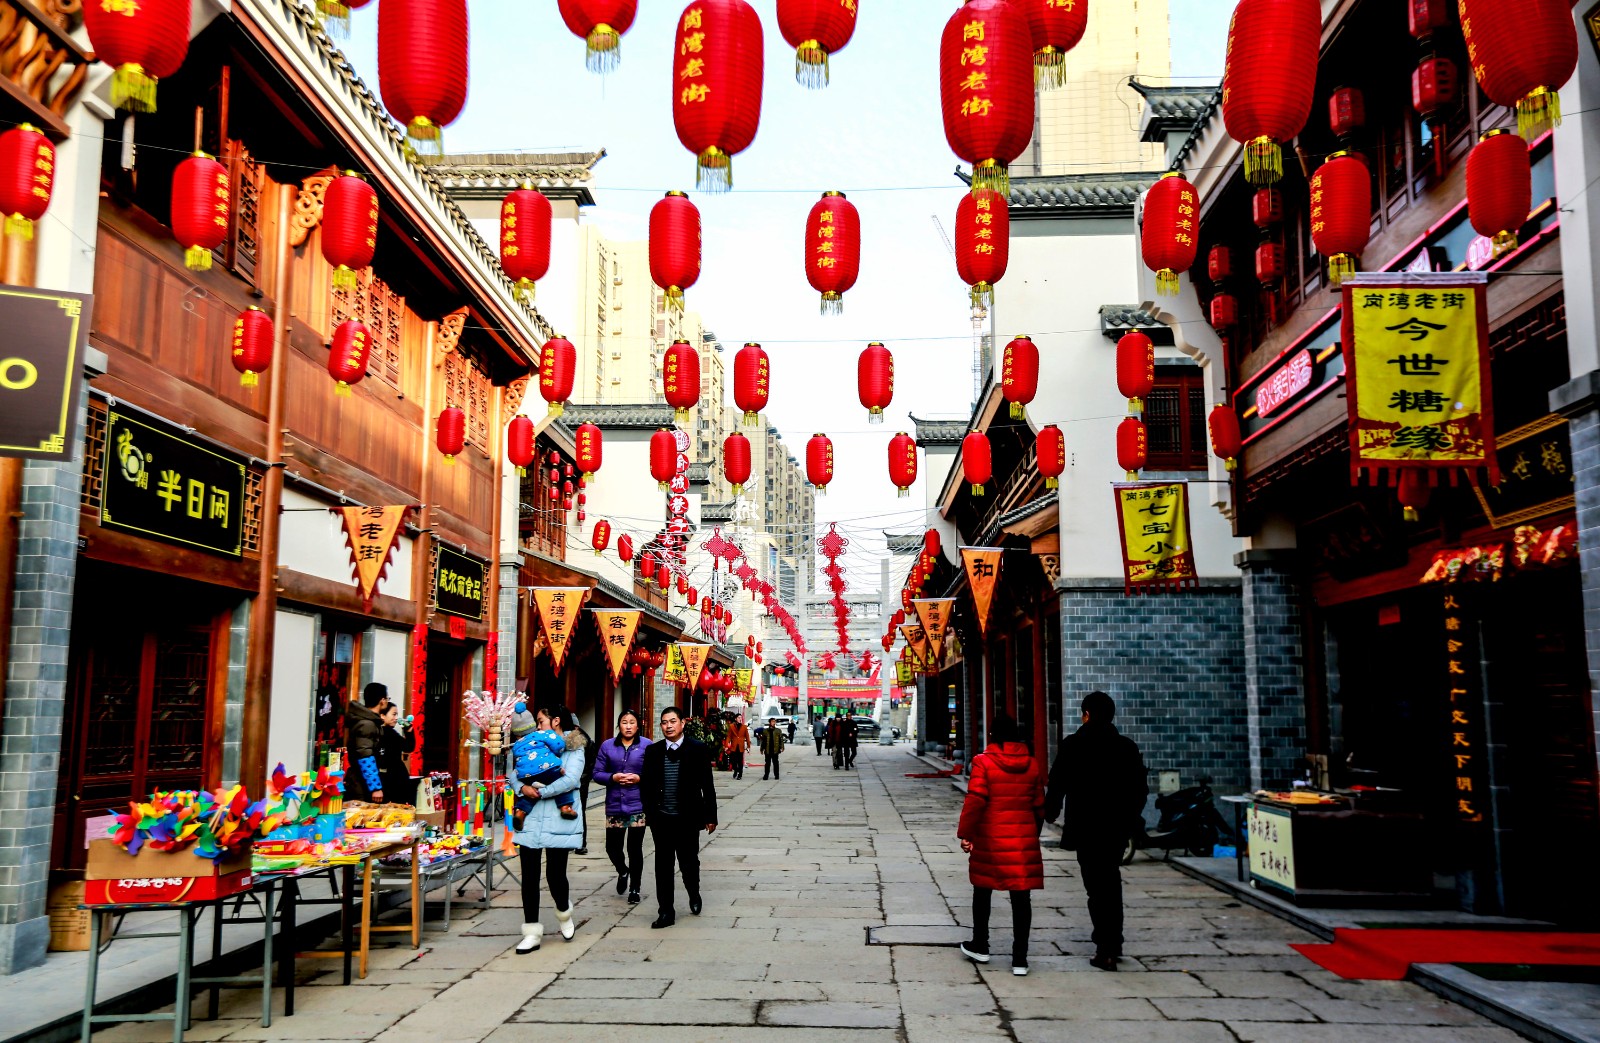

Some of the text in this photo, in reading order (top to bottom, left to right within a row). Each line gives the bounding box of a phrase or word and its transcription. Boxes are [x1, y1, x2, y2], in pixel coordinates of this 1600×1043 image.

[680, 7, 711, 105] 岗湾老街
[960, 20, 993, 117] 岗湾老街
[503, 201, 521, 258] 岗湾老街
[817, 210, 837, 269] 岗湾老街
[974, 198, 995, 256] 岗湾老街
[1174, 190, 1194, 247] 岗湾老街
[1363, 292, 1466, 310] 岗湾老街
[1385, 317, 1453, 450] 今世糖缘
[156, 469, 230, 529] 半日闲
[1138, 502, 1176, 574] 七宝小吃
[973, 558, 994, 582] 和
[550, 592, 566, 646] 岗湾老街
[609, 615, 627, 647] 客栈
